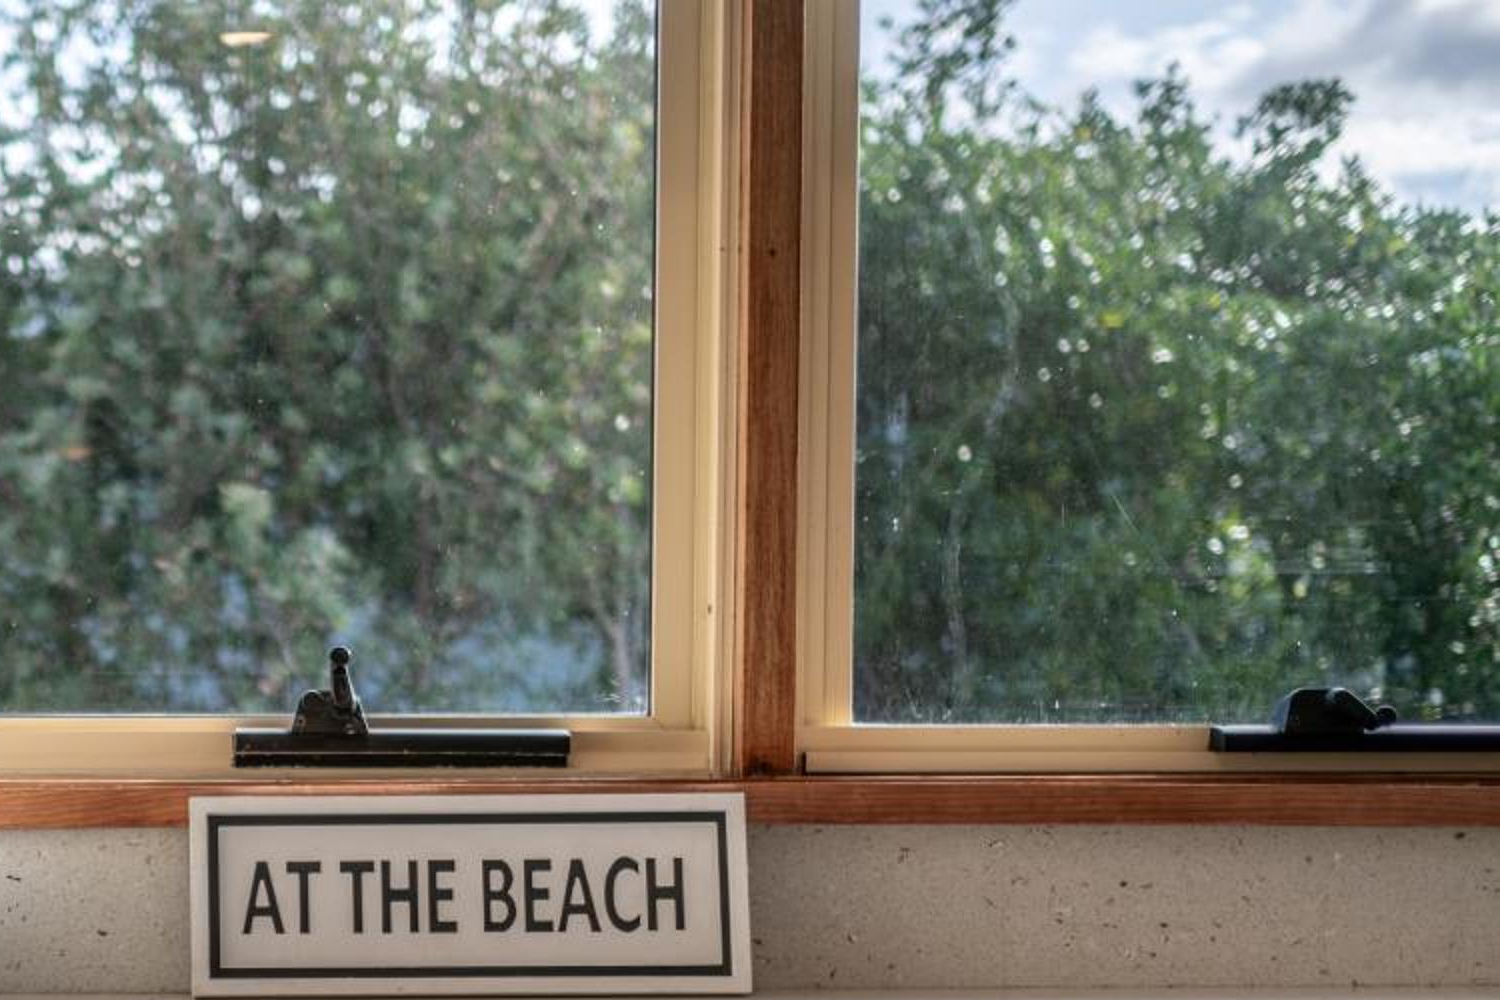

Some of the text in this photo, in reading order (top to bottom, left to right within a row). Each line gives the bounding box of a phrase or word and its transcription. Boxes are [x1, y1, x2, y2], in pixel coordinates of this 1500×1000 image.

[242, 855, 687, 935] AT THE BEACH
